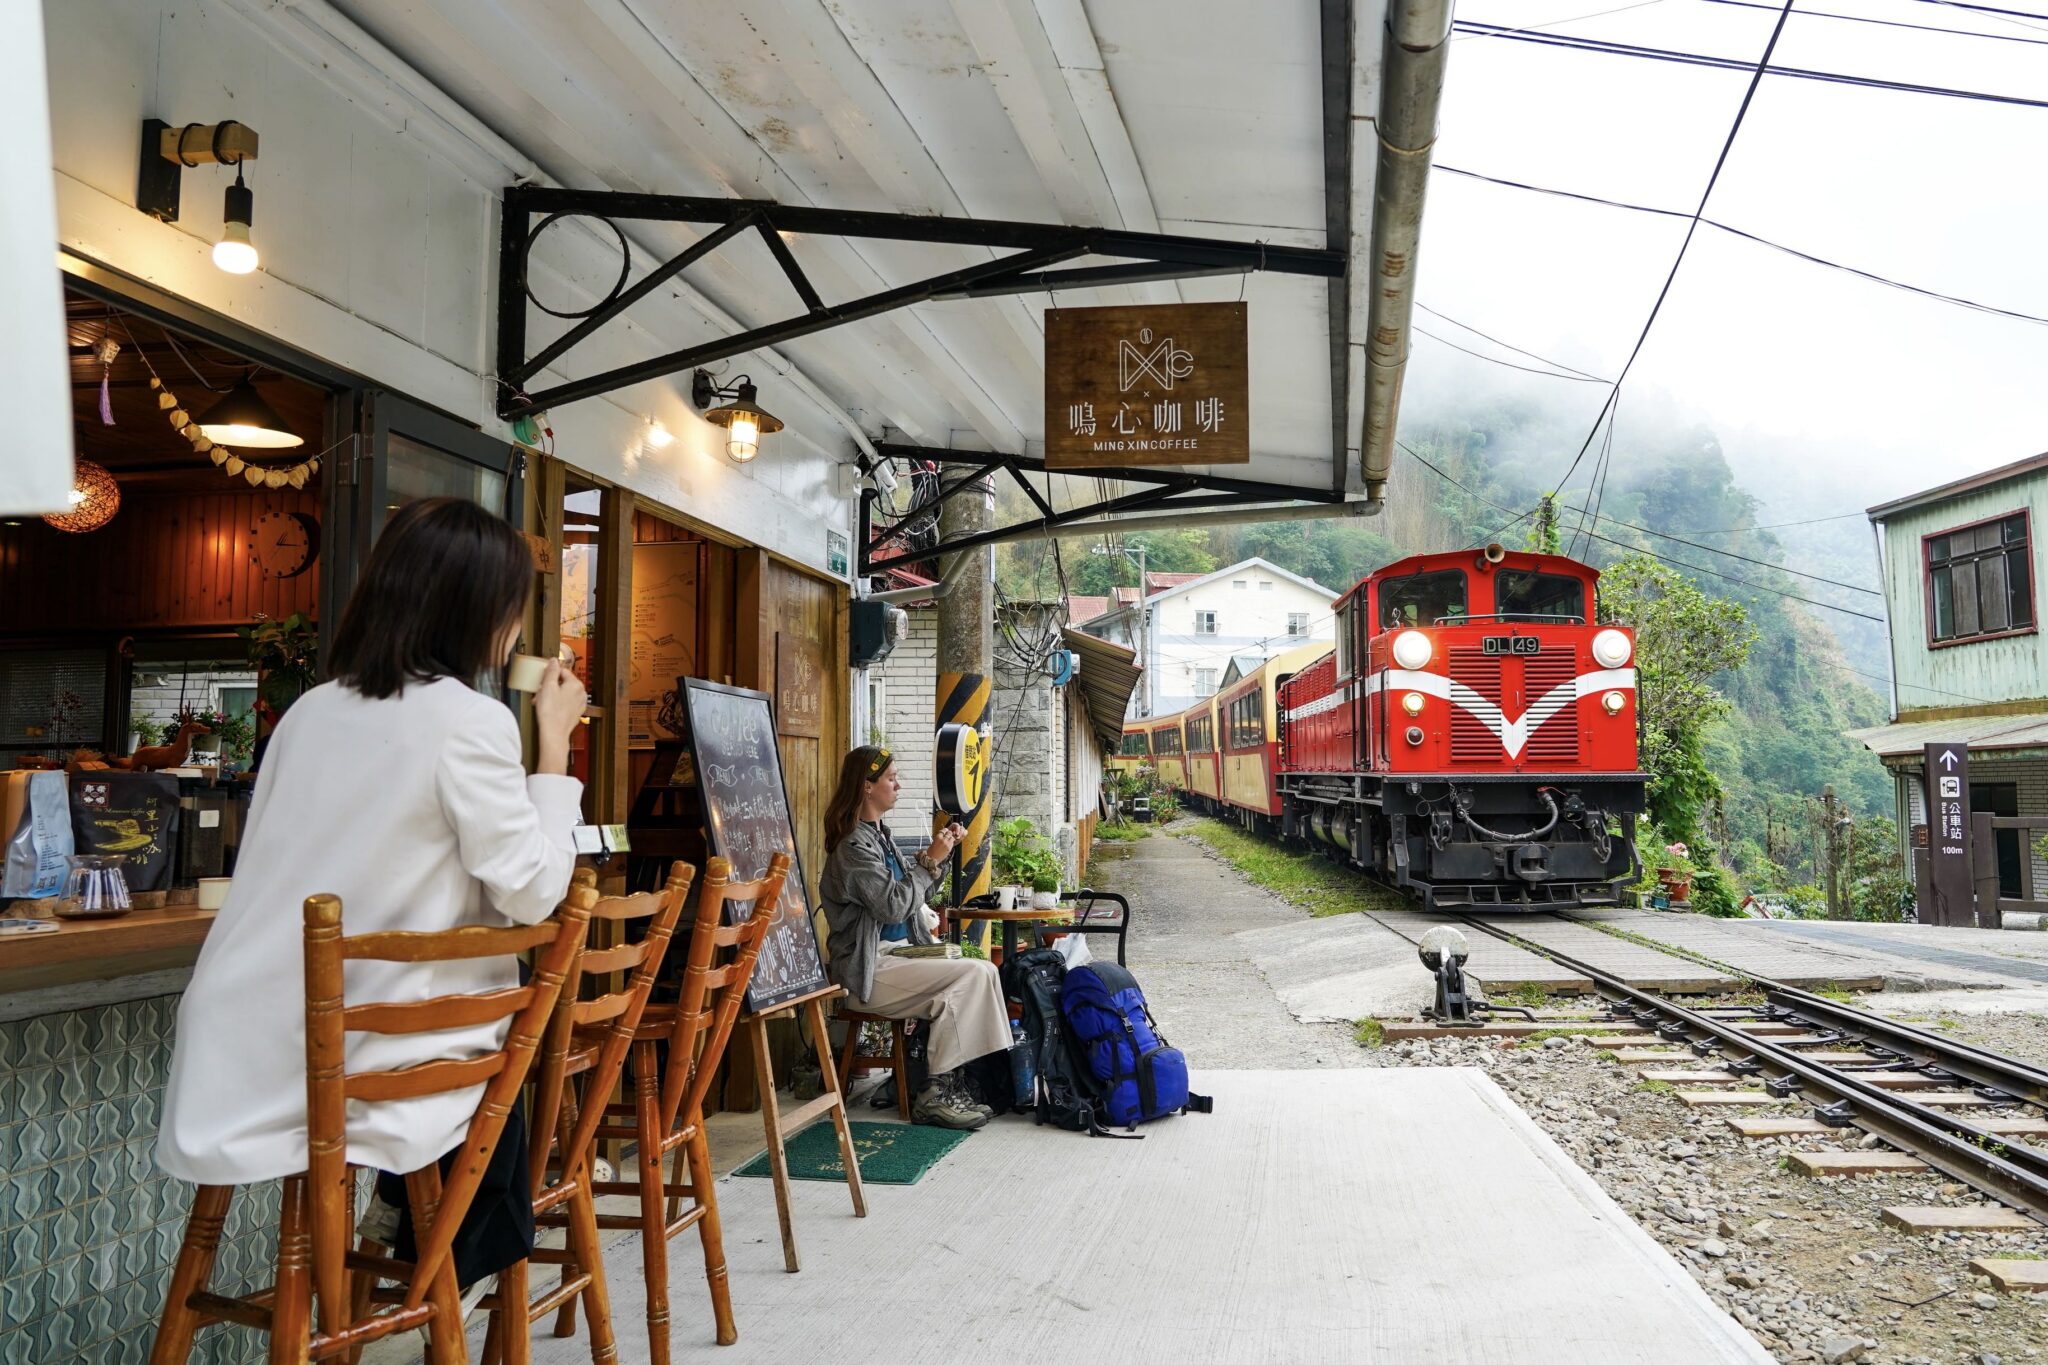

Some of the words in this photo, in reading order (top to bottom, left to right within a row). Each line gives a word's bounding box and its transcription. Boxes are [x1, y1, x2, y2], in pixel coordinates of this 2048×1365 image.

[1069, 397, 1225, 437] 鳴心咖啡
[1093, 440, 1125, 451] MING
[1127, 440, 1149, 450] XIN
[1150, 438, 1198, 450] COFFEE
[1486, 638, 1508, 653] DL
[1515, 638, 1537, 652] 49
[1950, 802, 1962, 840] 公車站
[1942, 846, 1963, 854] 100m
